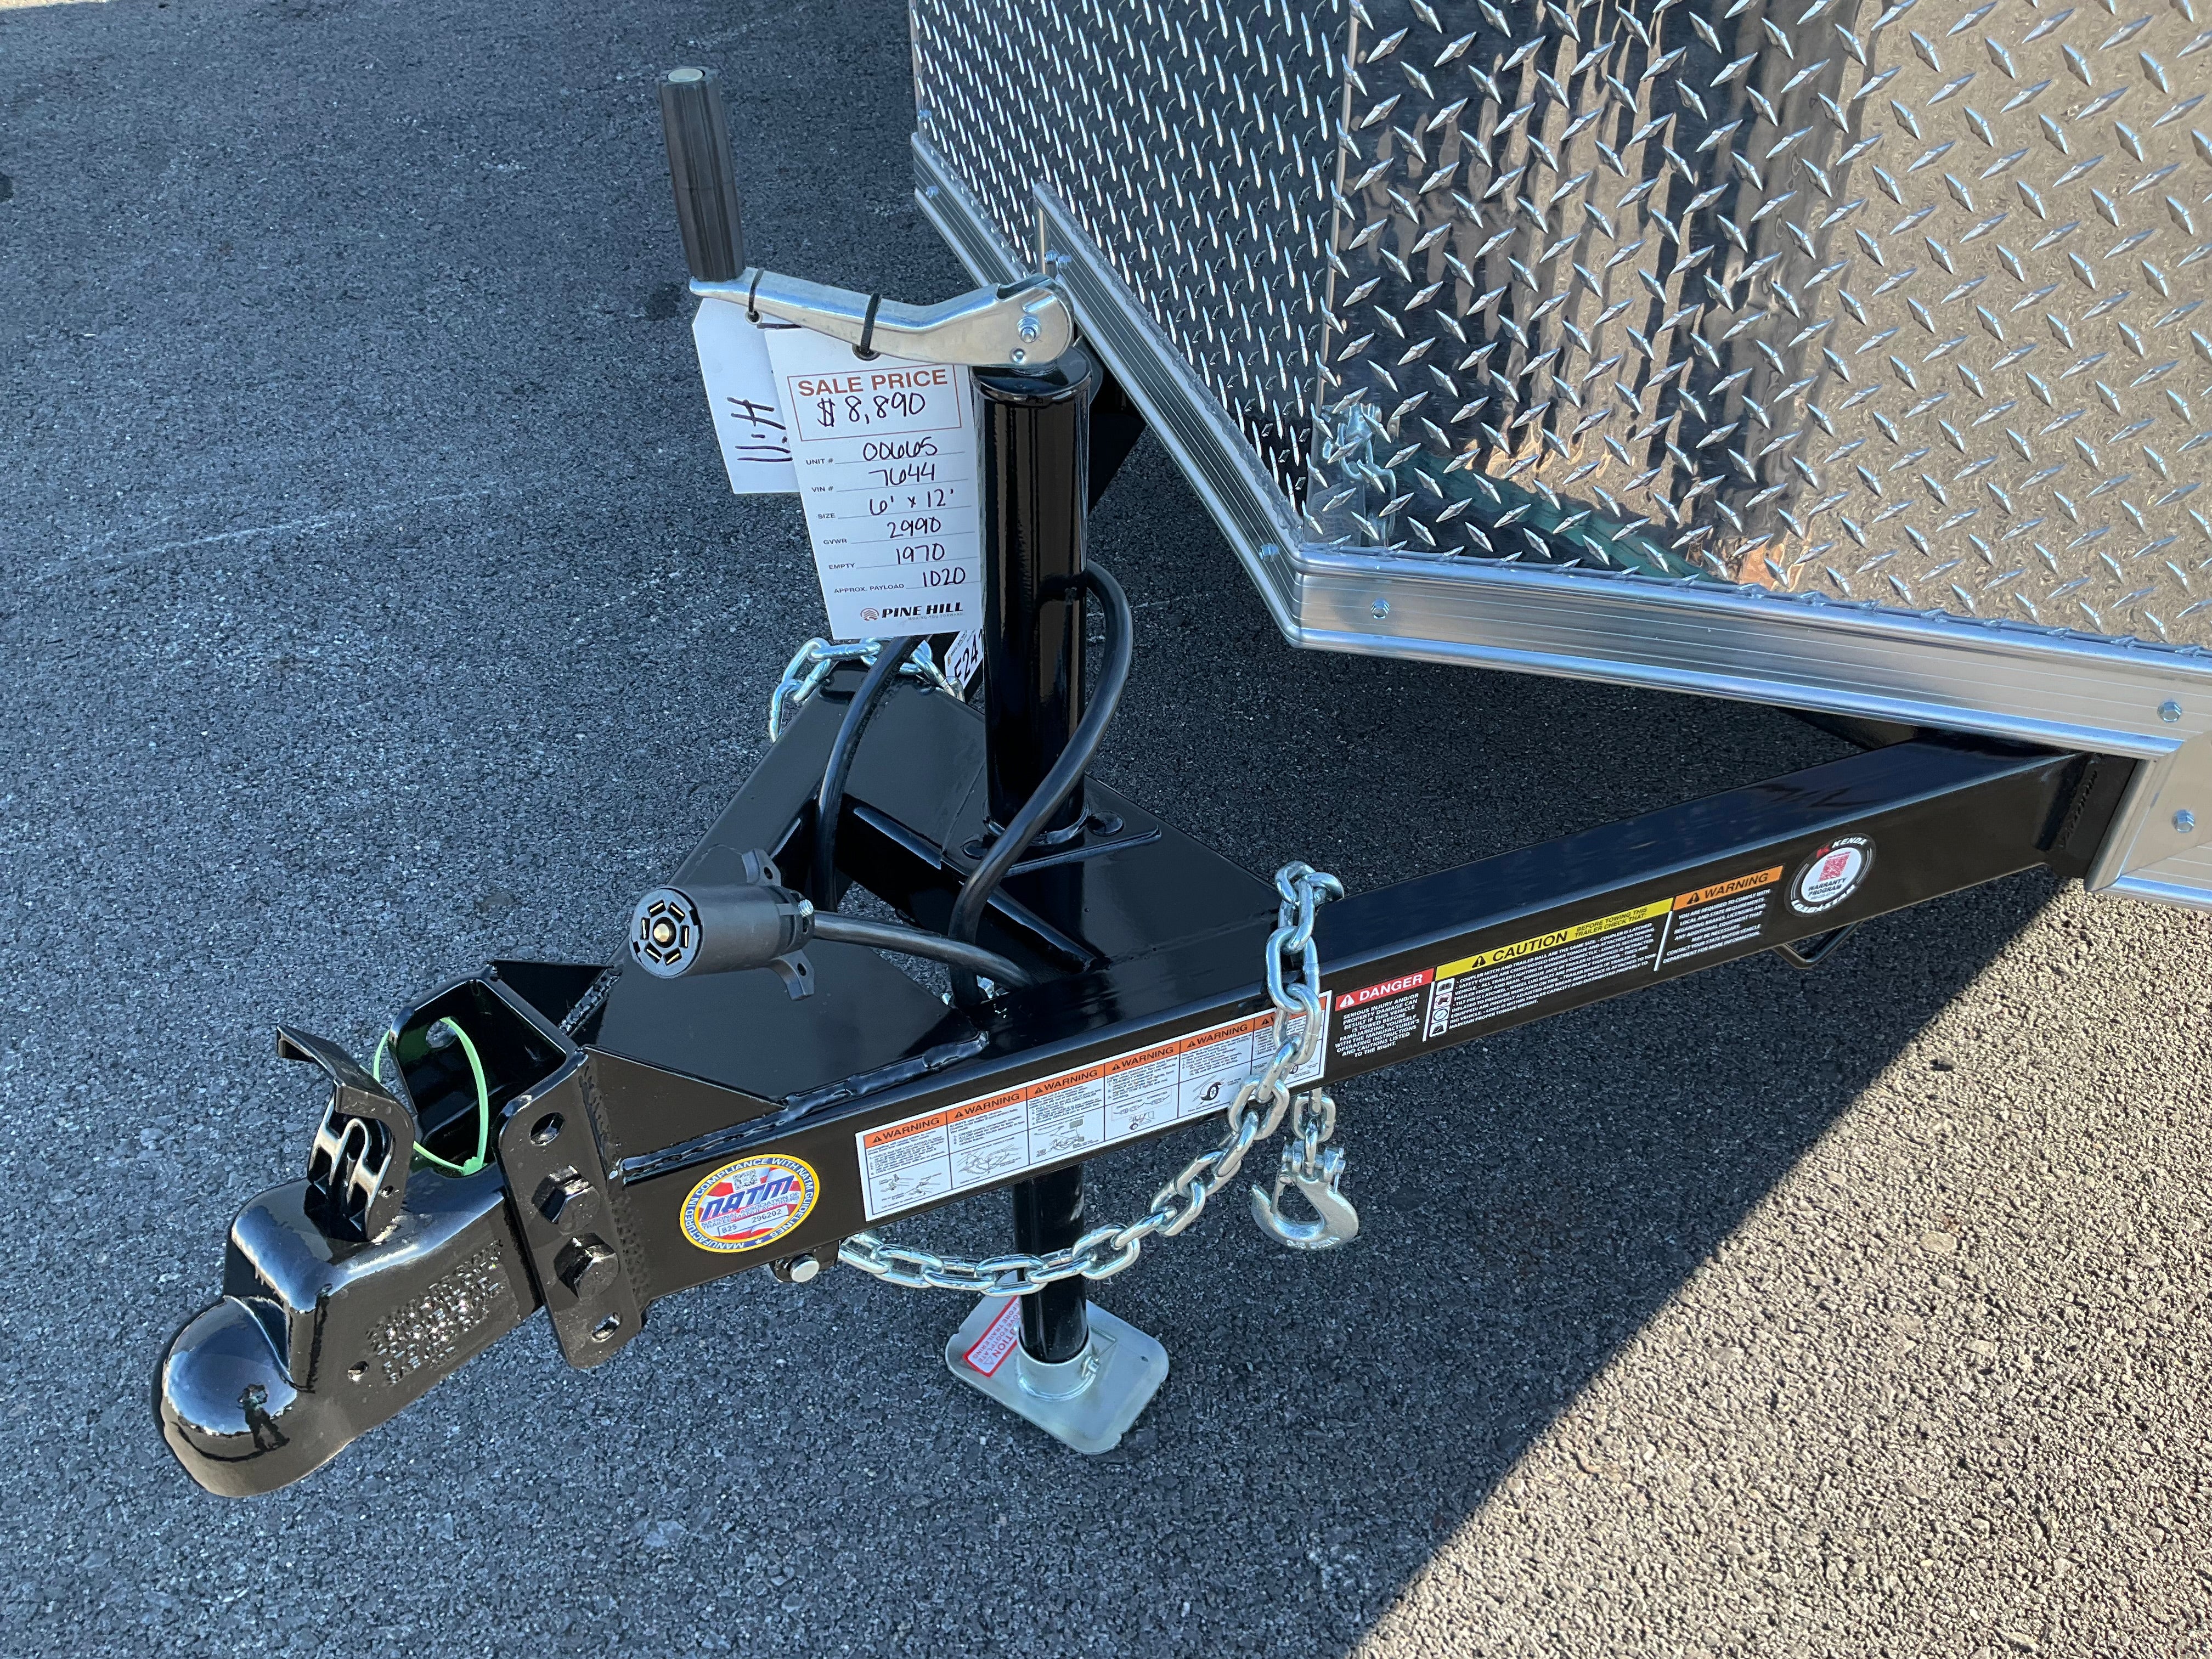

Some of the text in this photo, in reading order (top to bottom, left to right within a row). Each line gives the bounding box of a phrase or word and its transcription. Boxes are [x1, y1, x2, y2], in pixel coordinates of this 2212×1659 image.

[798, 369, 948, 396] SALE PRICE
[863, 436, 938, 461] 00665
[868, 462, 935, 487] 7644
[887, 517, 942, 539] 2990
[895, 543, 945, 565] 1970
[923, 567, 966, 588] 1020
[882, 602, 963, 618] PINE HILL
[1832, 837, 1867, 848] KENDA
[1705, 873, 1769, 899] WARNING
[1808, 878, 1848, 891] WARRANTY
[1808, 884, 1843, 897] PROGRAM
[1701, 901, 1726, 913] REQUIRED
[1735, 893, 1755, 903] COMPLY
[1756, 888, 1770, 896] WITH
[1575, 926, 1601, 938] TRAILER
[1604, 918, 1626, 929] CHECK
[1577, 920, 1603, 932] BEFORE
[1605, 912, 1631, 923] TOWING
[1674, 922, 1704, 934] REGARDING
[1726, 907, 1753, 918] LICENSING
[1679, 917, 1696, 926] LOCAL
[1709, 909, 1724, 917] STATE
[1686, 924, 1717, 937] ADDITIONAL
[1719, 915, 1748, 927] EQUIPMENT
[1459, 972, 1483, 983] COUPLER
[1484, 967, 1499, 975] HITCH
[1513, 957, 1533, 967] TRAILER
[1569, 942, 1584, 950] SAME
[1600, 930, 1623, 941] COUPLER
[1629, 922, 1651, 933] LATCHED
[1492, 930, 1567, 962] CAUTION
[1662, 950, 1697, 964] DEPARTMENT
[1708, 941, 1723, 950] MORE
[1667, 924, 1760, 956] CONTACT YOUR STATE MOTOR VEHICLE
[1455, 985, 1477, 995] VEHICLE.
[1492, 974, 1512, 984] TRAILER
[1513, 967, 1537, 978] LIGHTING
[1543, 958, 1568, 968] WORKING
[1601, 944, 1615, 952] LOAD
[1621, 935, 1644, 946] SECURED
[1458, 979, 1478, 989] SAFETY
[1479, 973, 1498, 983] CHAINS
[1510, 958, 1547, 974] CRISSCROSSED
[1548, 953, 1566, 962] UNDER
[1567, 946, 1587, 956] TONGUE
[1600, 935, 1626, 946] ATTACHED
[1634, 927, 1655, 936] TOWING
[1359, 974, 1423, 1002] DANGER
[1343, 992, 1418, 1019] SERIOUS INJURY AND/OR
[1343, 1012, 1374, 1025] PROPERTY
[1377, 1003, 1402, 1014] DAMAGE
[1344, 1019, 1366, 1030] RESULT
[1390, 1004, 1415, 1015] VEHICLE
[1335, 1039, 1351, 1048] WITH
[1365, 1018, 1419, 1039] MANUFACTURER'S
[1340, 1014, 1417, 1041] FAMILIARIZING YOURSELF
[1359, 1019, 1381, 1030] TOWED
[1383, 1012, 1406, 1023] BEFORE
[1197, 1024, 1248, 1045] WARNING
[1336, 1024, 1417, 1053] OPERATING INSTRUCTIONS
[1342, 1031, 1410, 1056] AND CAUTIONS LISTED
[1377, 1040, 1396, 1050] RIGHT.
[1121, 1047, 1174, 1068] WARNING
[1044, 1069, 1098, 1091] WARNING
[964, 1093, 1020, 1115] WARNING
[883, 1118, 939, 1139] WARNING
[685, 1158, 814, 1249] MANUFACTURED IN COMPLIANCE WITH NATM GUIDELINES
[701, 1212, 737, 1227] NATIONAL
[740, 1195, 788, 1214] ASSOCIATION
[721, 1209, 782, 1234] B25 296202
[972, 1324, 1002, 1359] TRAILERING
[978, 1329, 1008, 1362] FOOTPLATE
